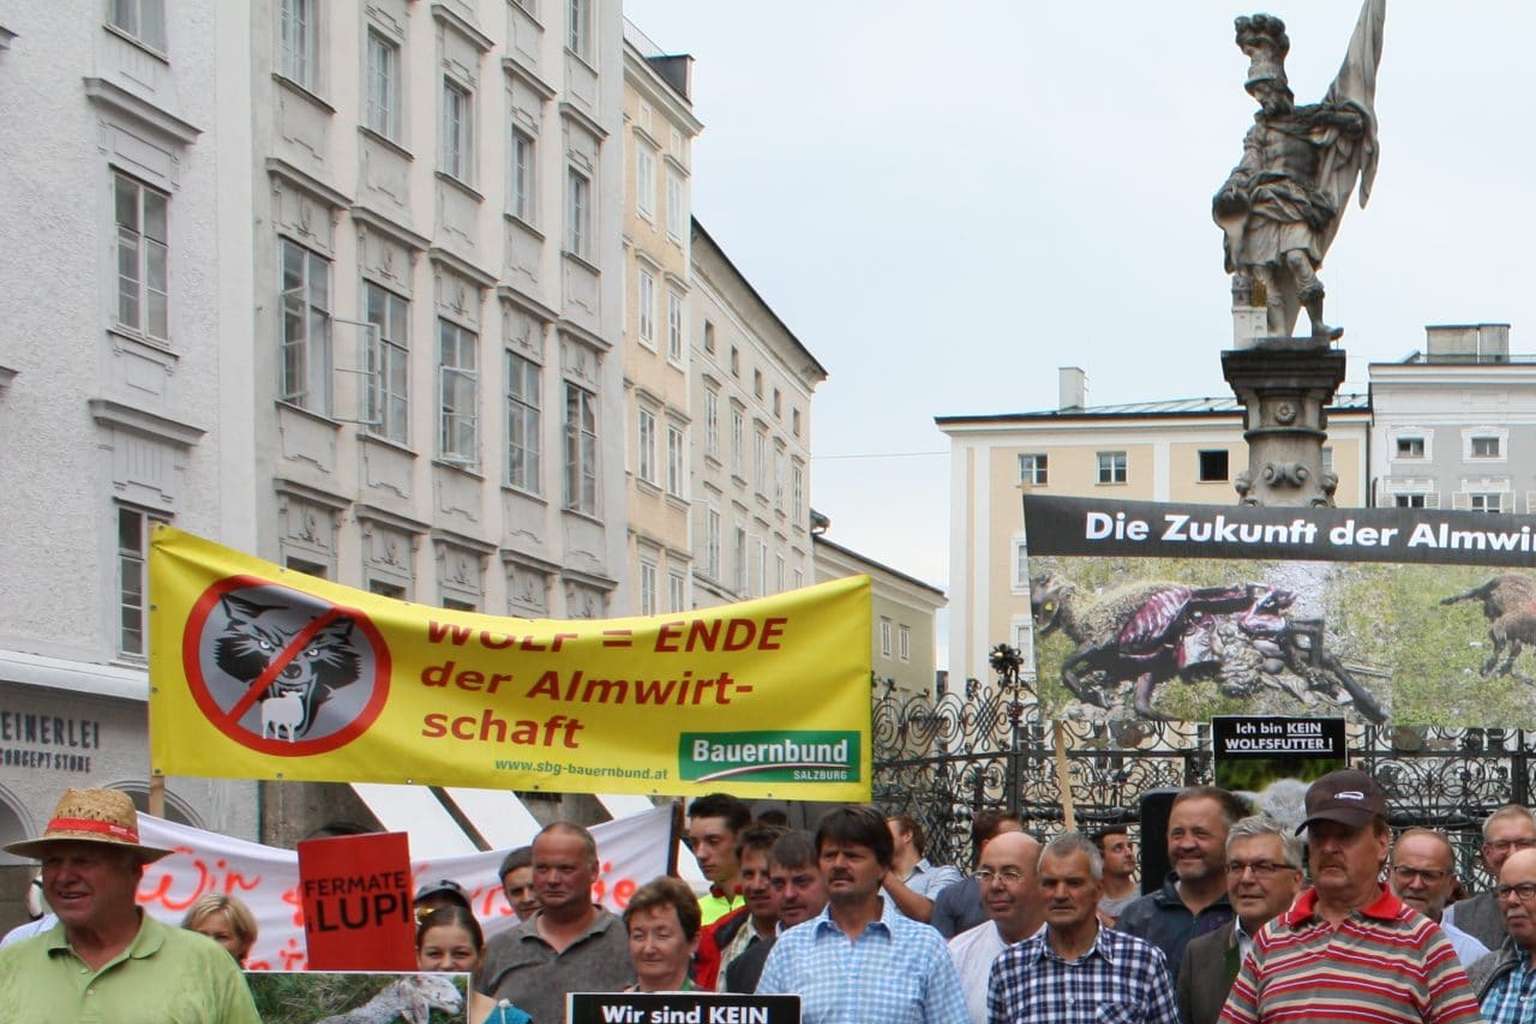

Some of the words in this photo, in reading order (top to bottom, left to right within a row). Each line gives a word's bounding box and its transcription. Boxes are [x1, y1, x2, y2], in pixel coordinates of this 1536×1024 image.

[1086, 512, 1149, 540] Die
[1161, 514, 1317, 544] Zukunft
[1329, 520, 1399, 546] der
[654, 618, 788, 653] ENDE
[420, 660, 513, 694] der
[525, 671, 753, 706] Almwirt-
[1, 711, 99, 749] EINERLEI
[421, 709, 585, 749] schaft
[1236, 722, 1256, 734] Ich
[1260, 722, 1283, 734] bin
[1286, 722, 1322, 734] KEIN
[692, 740, 848, 762] Bauernbund
[1225, 738, 1324, 750] WOLFSFUTTER
[55, 754, 91, 774] STORE
[495, 758, 668, 781] www.sbg-bauernbund.at
[793, 771, 847, 780] SALZBURG
[303, 871, 407, 898] FERMATE
[318, 892, 411, 934] LUPI
[601, 1005, 645, 1024] Wir
[651, 1006, 700, 1024] sind
[709, 1007, 768, 1024] KEIN
